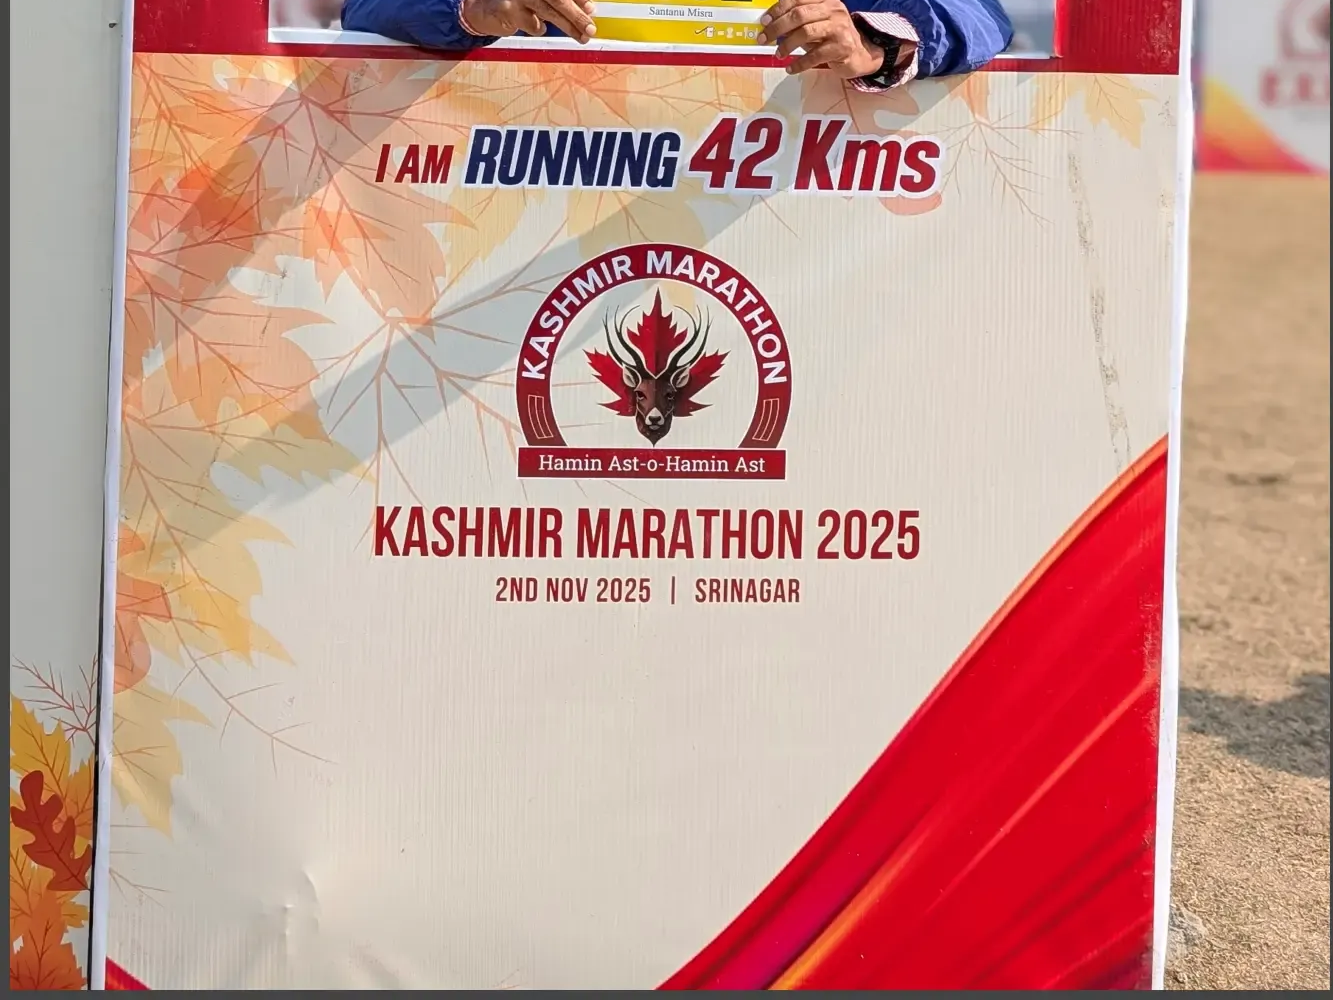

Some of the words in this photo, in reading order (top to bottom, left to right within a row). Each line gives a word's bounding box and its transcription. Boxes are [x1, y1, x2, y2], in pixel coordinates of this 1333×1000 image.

[649, 6, 685, 17] Santanu
[687, 8, 713, 18] Misra
[375, 142, 390, 183] I
[394, 144, 455, 184] AM
[464, 128, 680, 189] RUNNING
[688, 116, 785, 190] 42
[798, 118, 940, 192] Kms
[521, 255, 634, 380] KASHMIR
[646, 250, 787, 385] MARATHON
[538, 455, 602, 471] Hamin
[607, 455, 729, 473] Ast-o-Hamin
[735, 456, 765, 473] Ast
[374, 506, 563, 558] KASHMIR
[576, 507, 802, 560] MARATHON
[817, 509, 921, 560] 2025
[495, 577, 538, 603] 2ND
[546, 577, 588, 603] NOV
[596, 577, 651, 604] 2025
[694, 578, 801, 604] SRINAGAR
